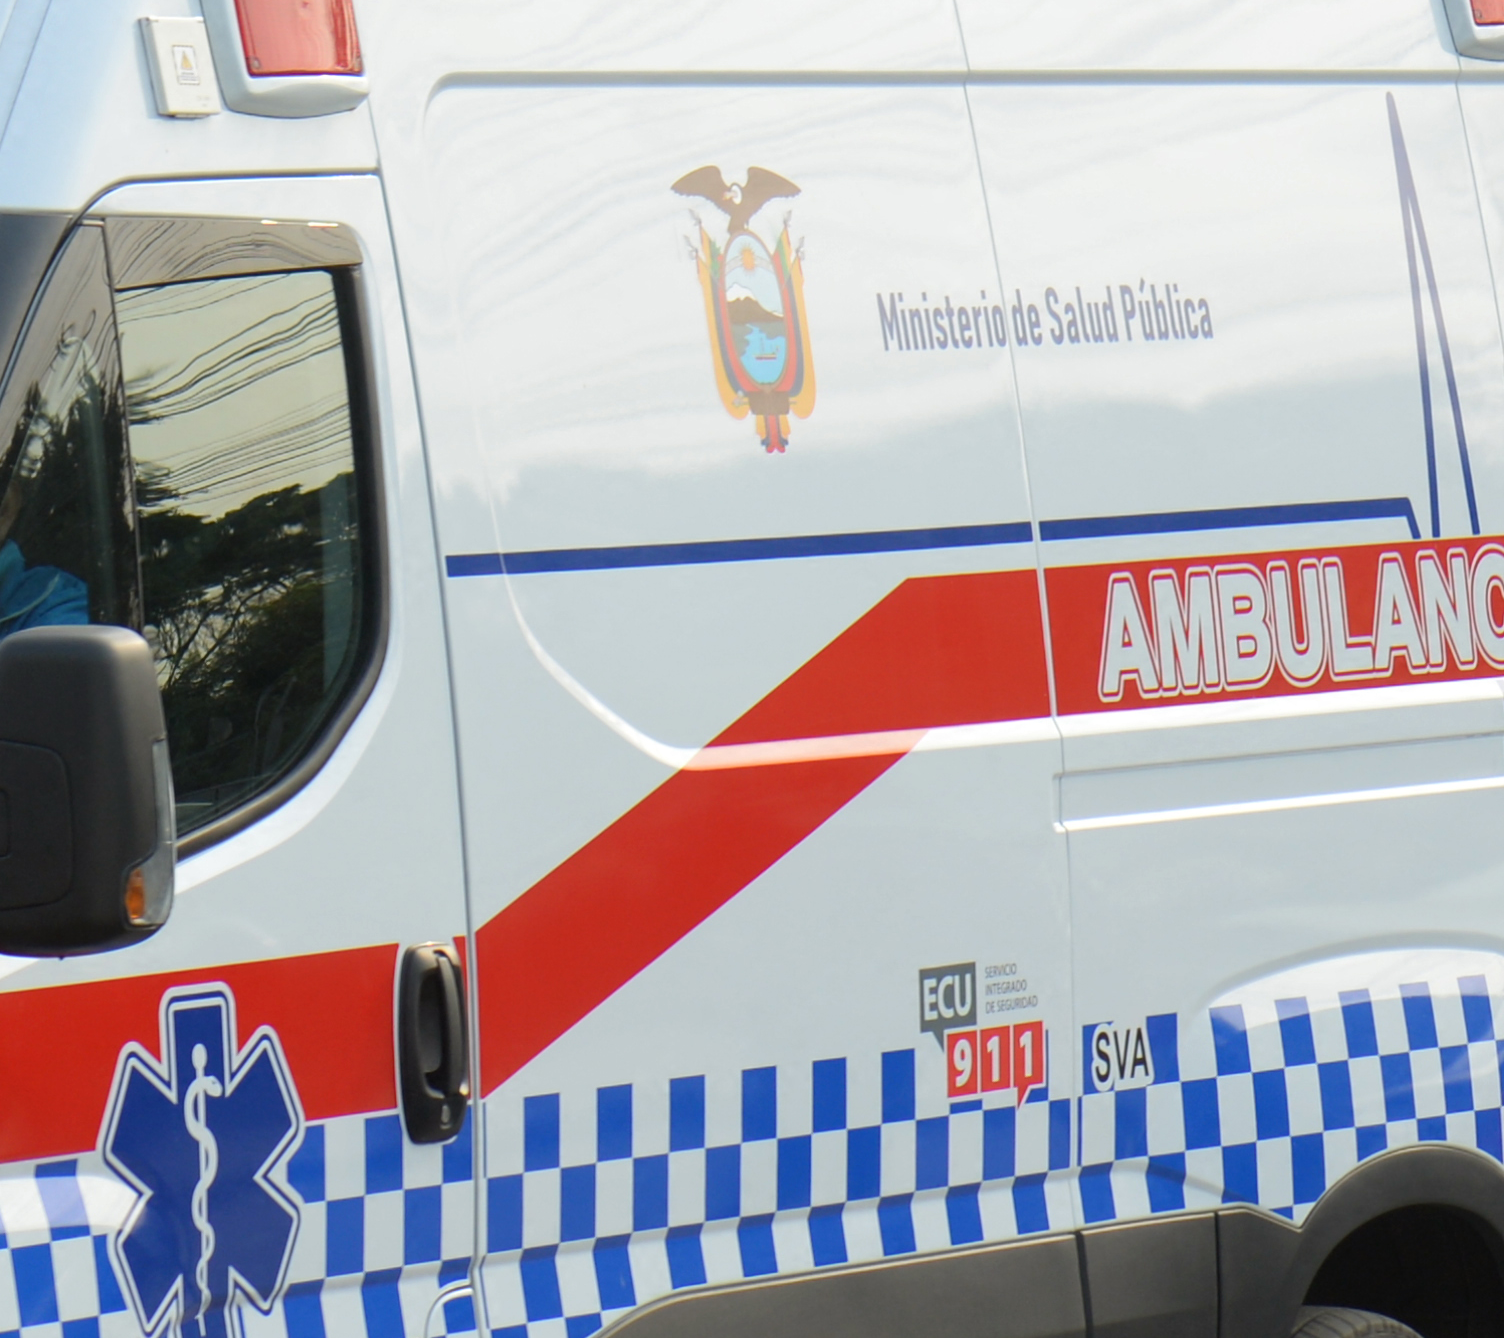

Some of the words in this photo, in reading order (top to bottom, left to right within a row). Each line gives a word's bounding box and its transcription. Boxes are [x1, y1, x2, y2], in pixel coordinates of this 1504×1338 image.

[876, 290, 1007, 351] Ministerio
[1011, 288, 1043, 347] de
[1045, 286, 1119, 346] Salud
[1119, 277, 1214, 342] Pública
[984, 963, 1017, 979] SERVICIO
[985, 979, 1028, 996] INTEGRADO
[923, 973, 972, 1021] ECU
[985, 1001, 995, 1014] DE
[997, 995, 1038, 1013] SEGURIDAD
[953, 1030, 1033, 1088] 911
[1094, 1027, 1150, 1081] SVA
